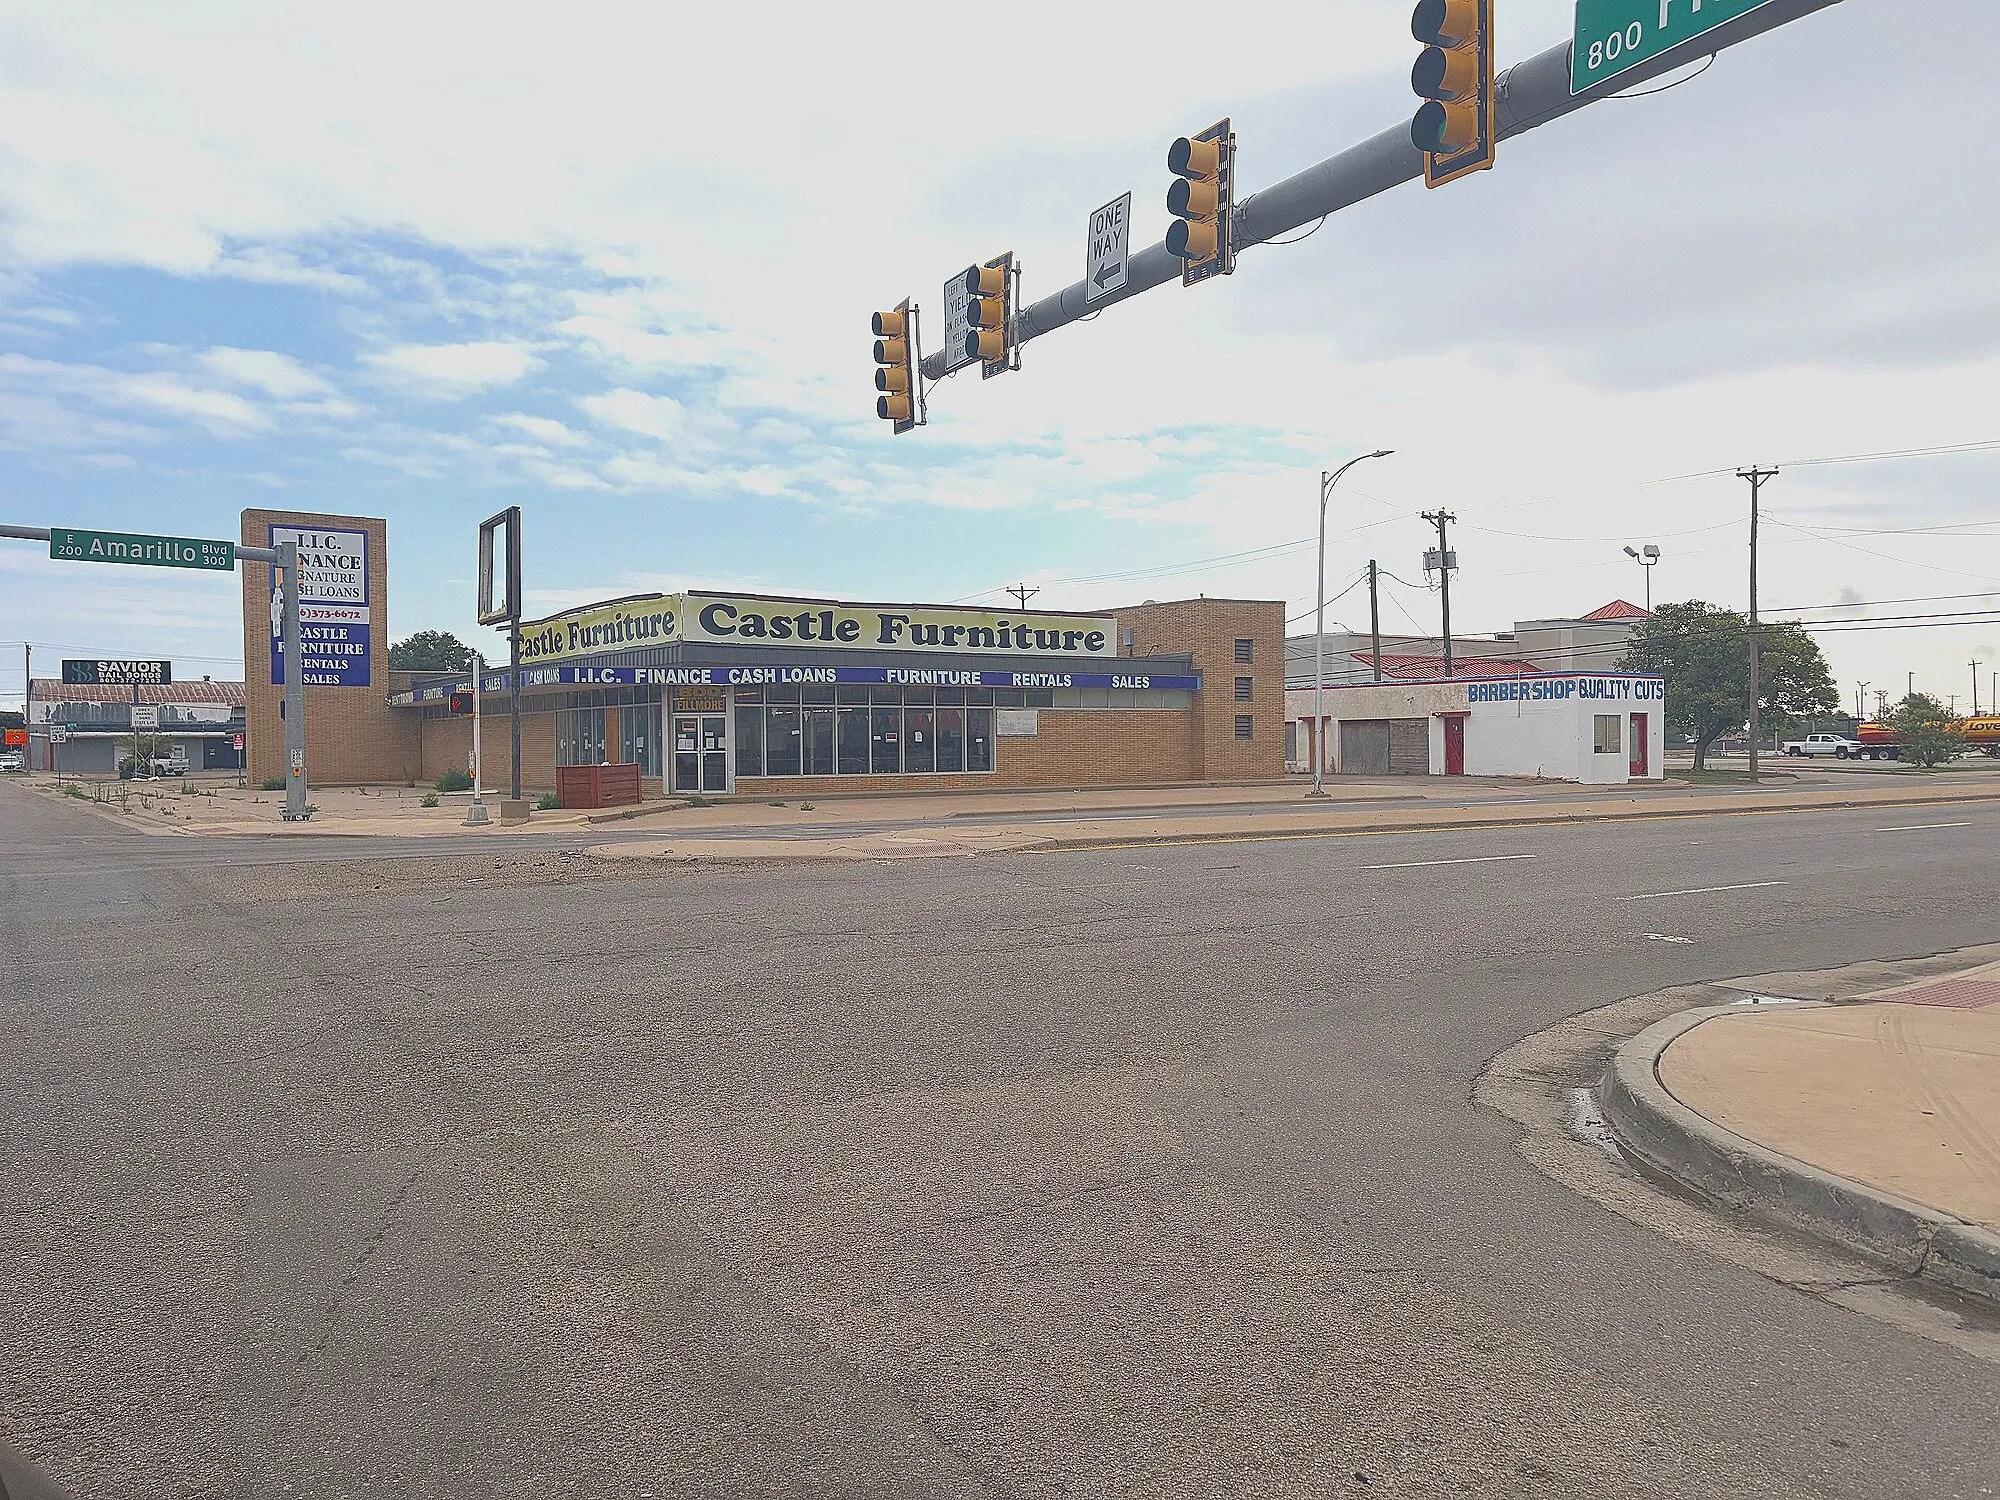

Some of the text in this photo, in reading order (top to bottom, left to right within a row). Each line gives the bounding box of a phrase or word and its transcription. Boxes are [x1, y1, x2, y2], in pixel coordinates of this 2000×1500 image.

[1588, 21, 1642, 70] 800
[1095, 202, 1123, 234] ONE
[1093, 227, 1123, 260] WAY
[67, 534, 74, 544] E
[58, 538, 196, 562] 200 Amarillo
[202, 544, 227, 555] Blvd
[203, 555, 226, 566] 300
[298, 552, 361, 570] NANCE
[298, 569, 356, 583] GNATURE
[298, 583, 360, 598] SH LOANS
[300, 608, 361, 619] 6)373-6672
[518, 609, 676, 658] Castle Furniture
[698, 603, 1106, 651] Castle Furniture
[277, 641, 364, 655] FRNITURE
[97, 661, 162, 673] SAVIOR
[303, 673, 340, 684] SALES
[484, 676, 501, 692] SALES
[529, 667, 560, 685] CASH LOANS
[573, 668, 837, 684] I.I.C. FINANCE CASH LOANS
[886, 669, 1150, 689] FURNITURE RENTALS SALES
[1578, 679, 1663, 700] QUALITY CUTS
[676, 700, 725, 710] FILLMORE
